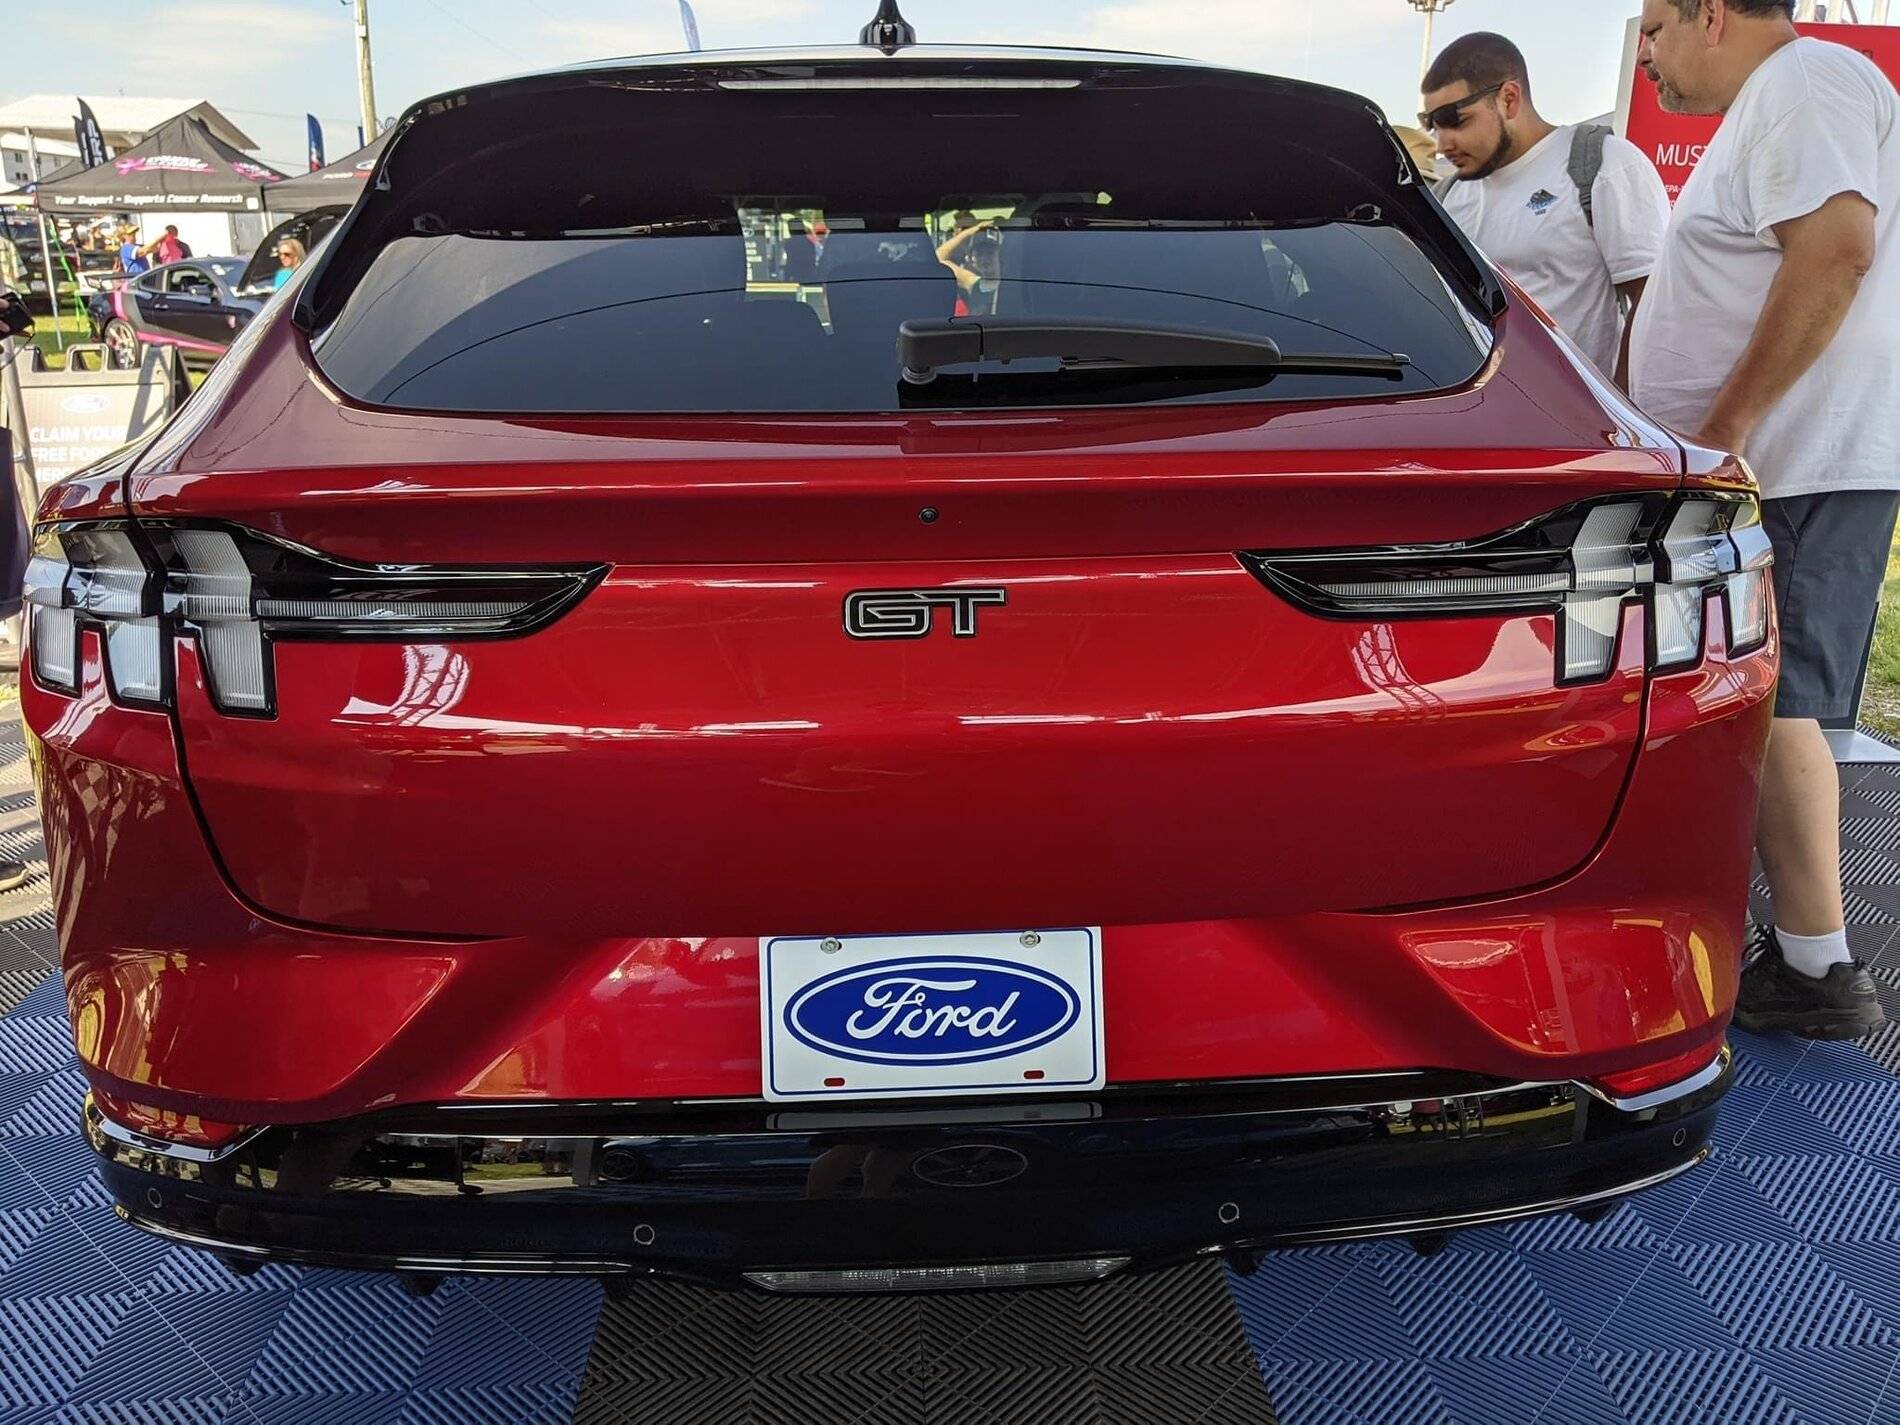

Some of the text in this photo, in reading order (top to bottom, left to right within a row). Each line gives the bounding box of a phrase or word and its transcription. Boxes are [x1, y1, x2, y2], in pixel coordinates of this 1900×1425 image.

[1655, 143, 1708, 167] MUS
[55, 195, 76, 204] Your
[77, 195, 113, 206] Support
[123, 194, 165, 206] Supports
[166, 194, 199, 203] Cancer
[200, 194, 243, 203] Research
[31, 425, 127, 443] CLAIM YOUR
[31, 446, 68, 462] FREE
[844, 588, 1006, 638] GT
[846, 977, 1020, 1039] Ford
